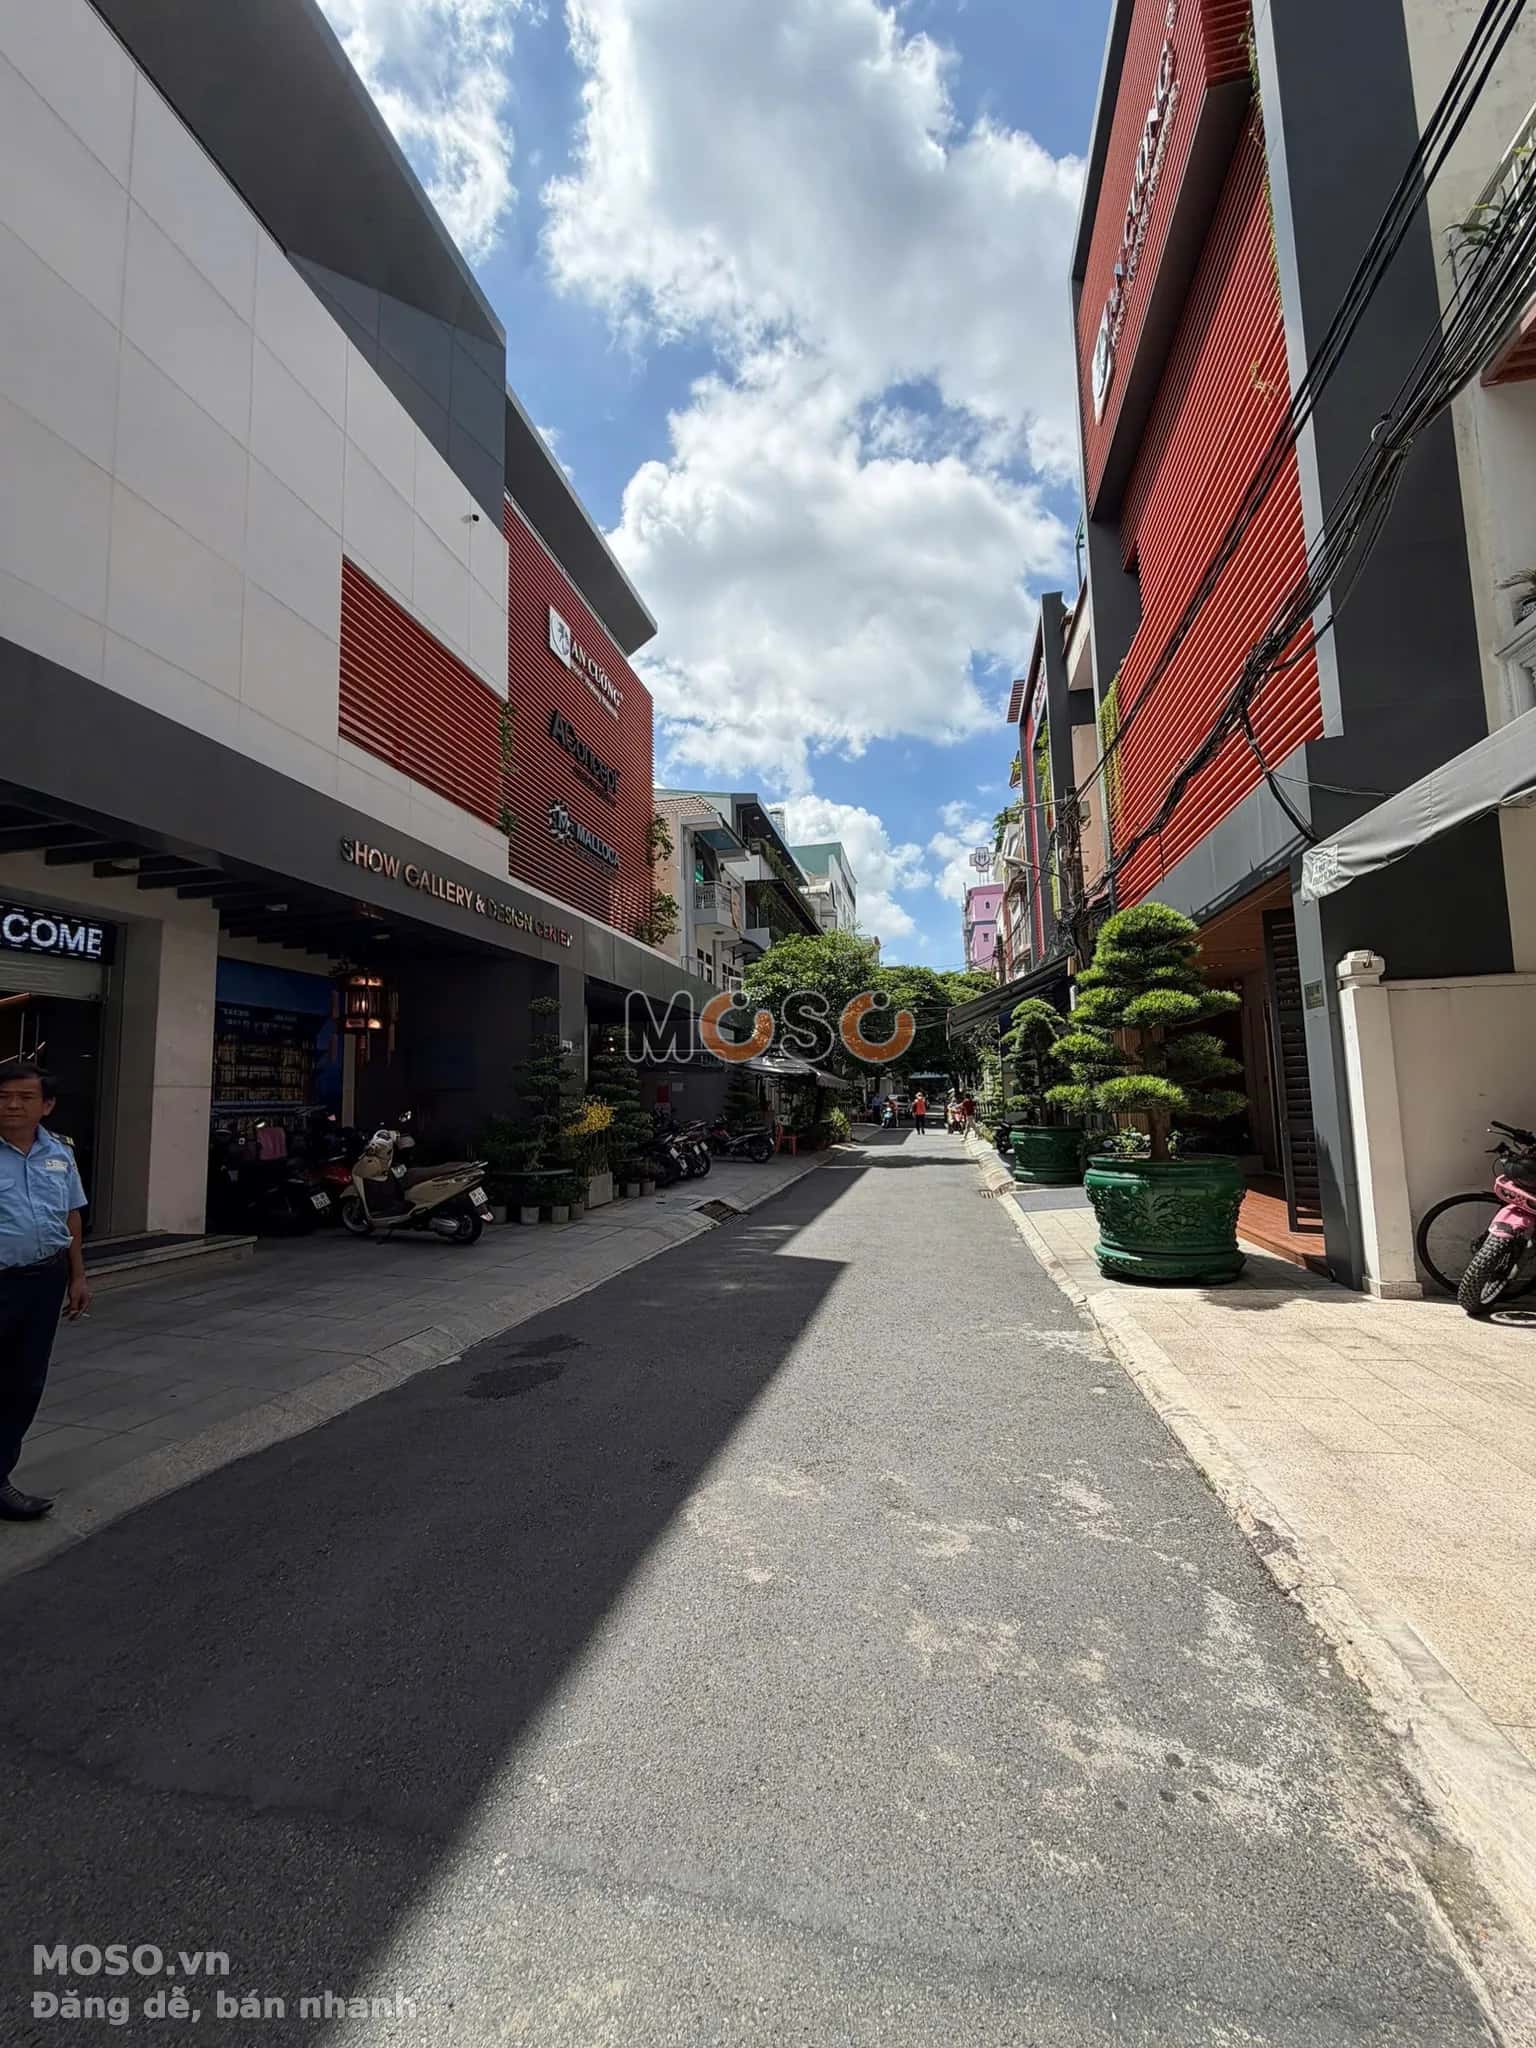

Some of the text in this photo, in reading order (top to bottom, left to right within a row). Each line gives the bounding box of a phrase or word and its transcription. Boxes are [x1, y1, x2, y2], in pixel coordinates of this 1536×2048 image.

[342, 837, 401, 879] SHOW
[404, 863, 473, 909] GALLERY
[474, 893, 486, 914] &
[487, 897, 534, 934] DESIGN
[0, 913, 103, 956] COME
